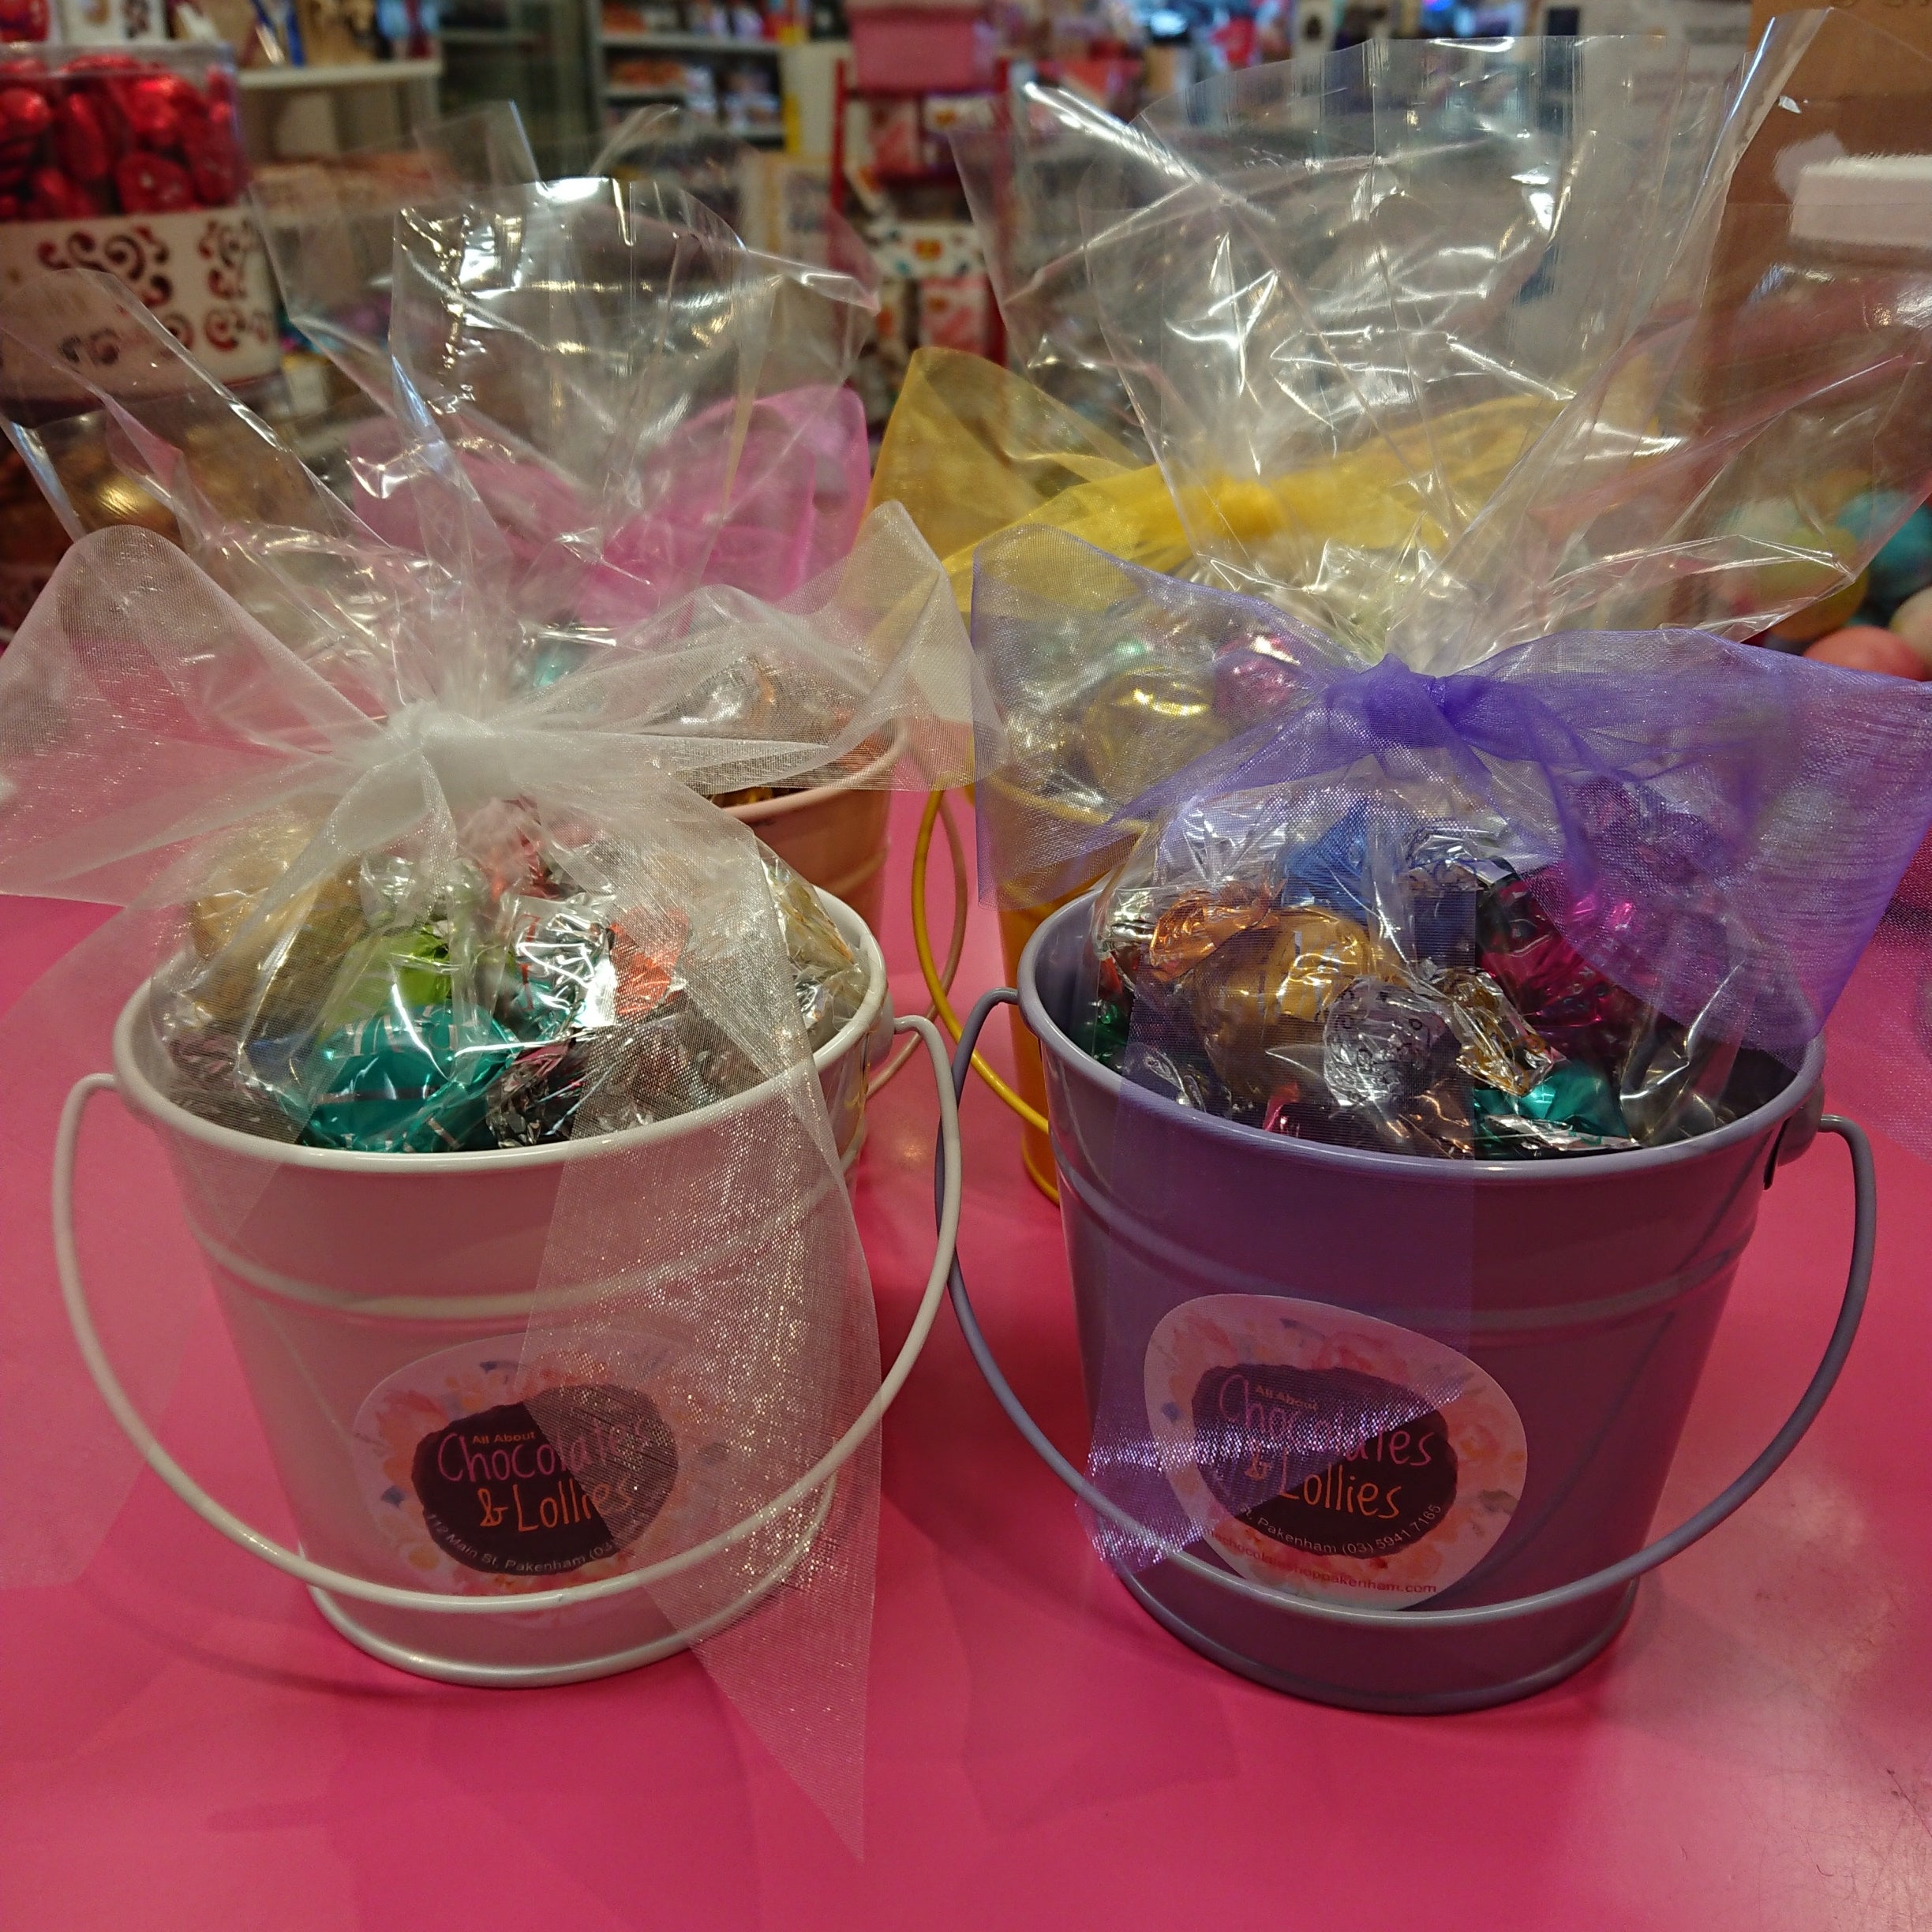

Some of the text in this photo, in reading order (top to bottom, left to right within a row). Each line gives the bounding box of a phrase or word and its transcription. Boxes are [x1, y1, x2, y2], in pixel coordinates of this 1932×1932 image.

[1255, 1384, 1318, 1412] All About
[472, 1431, 536, 1445] All About
[477, 1487, 510, 1528] &
[513, 1473, 632, 1533] Lollies
[1278, 1446, 1402, 1519] Lollies
[1256, 1516, 1337, 1555] Pakenham
[1341, 1541, 1374, 1556] (03)
[1375, 1529, 1411, 1549] 5941
[1409, 1503, 1442, 1532] 7165
[446, 1533, 478, 1559] Main
[504, 1556, 587, 1573] Pakenham
